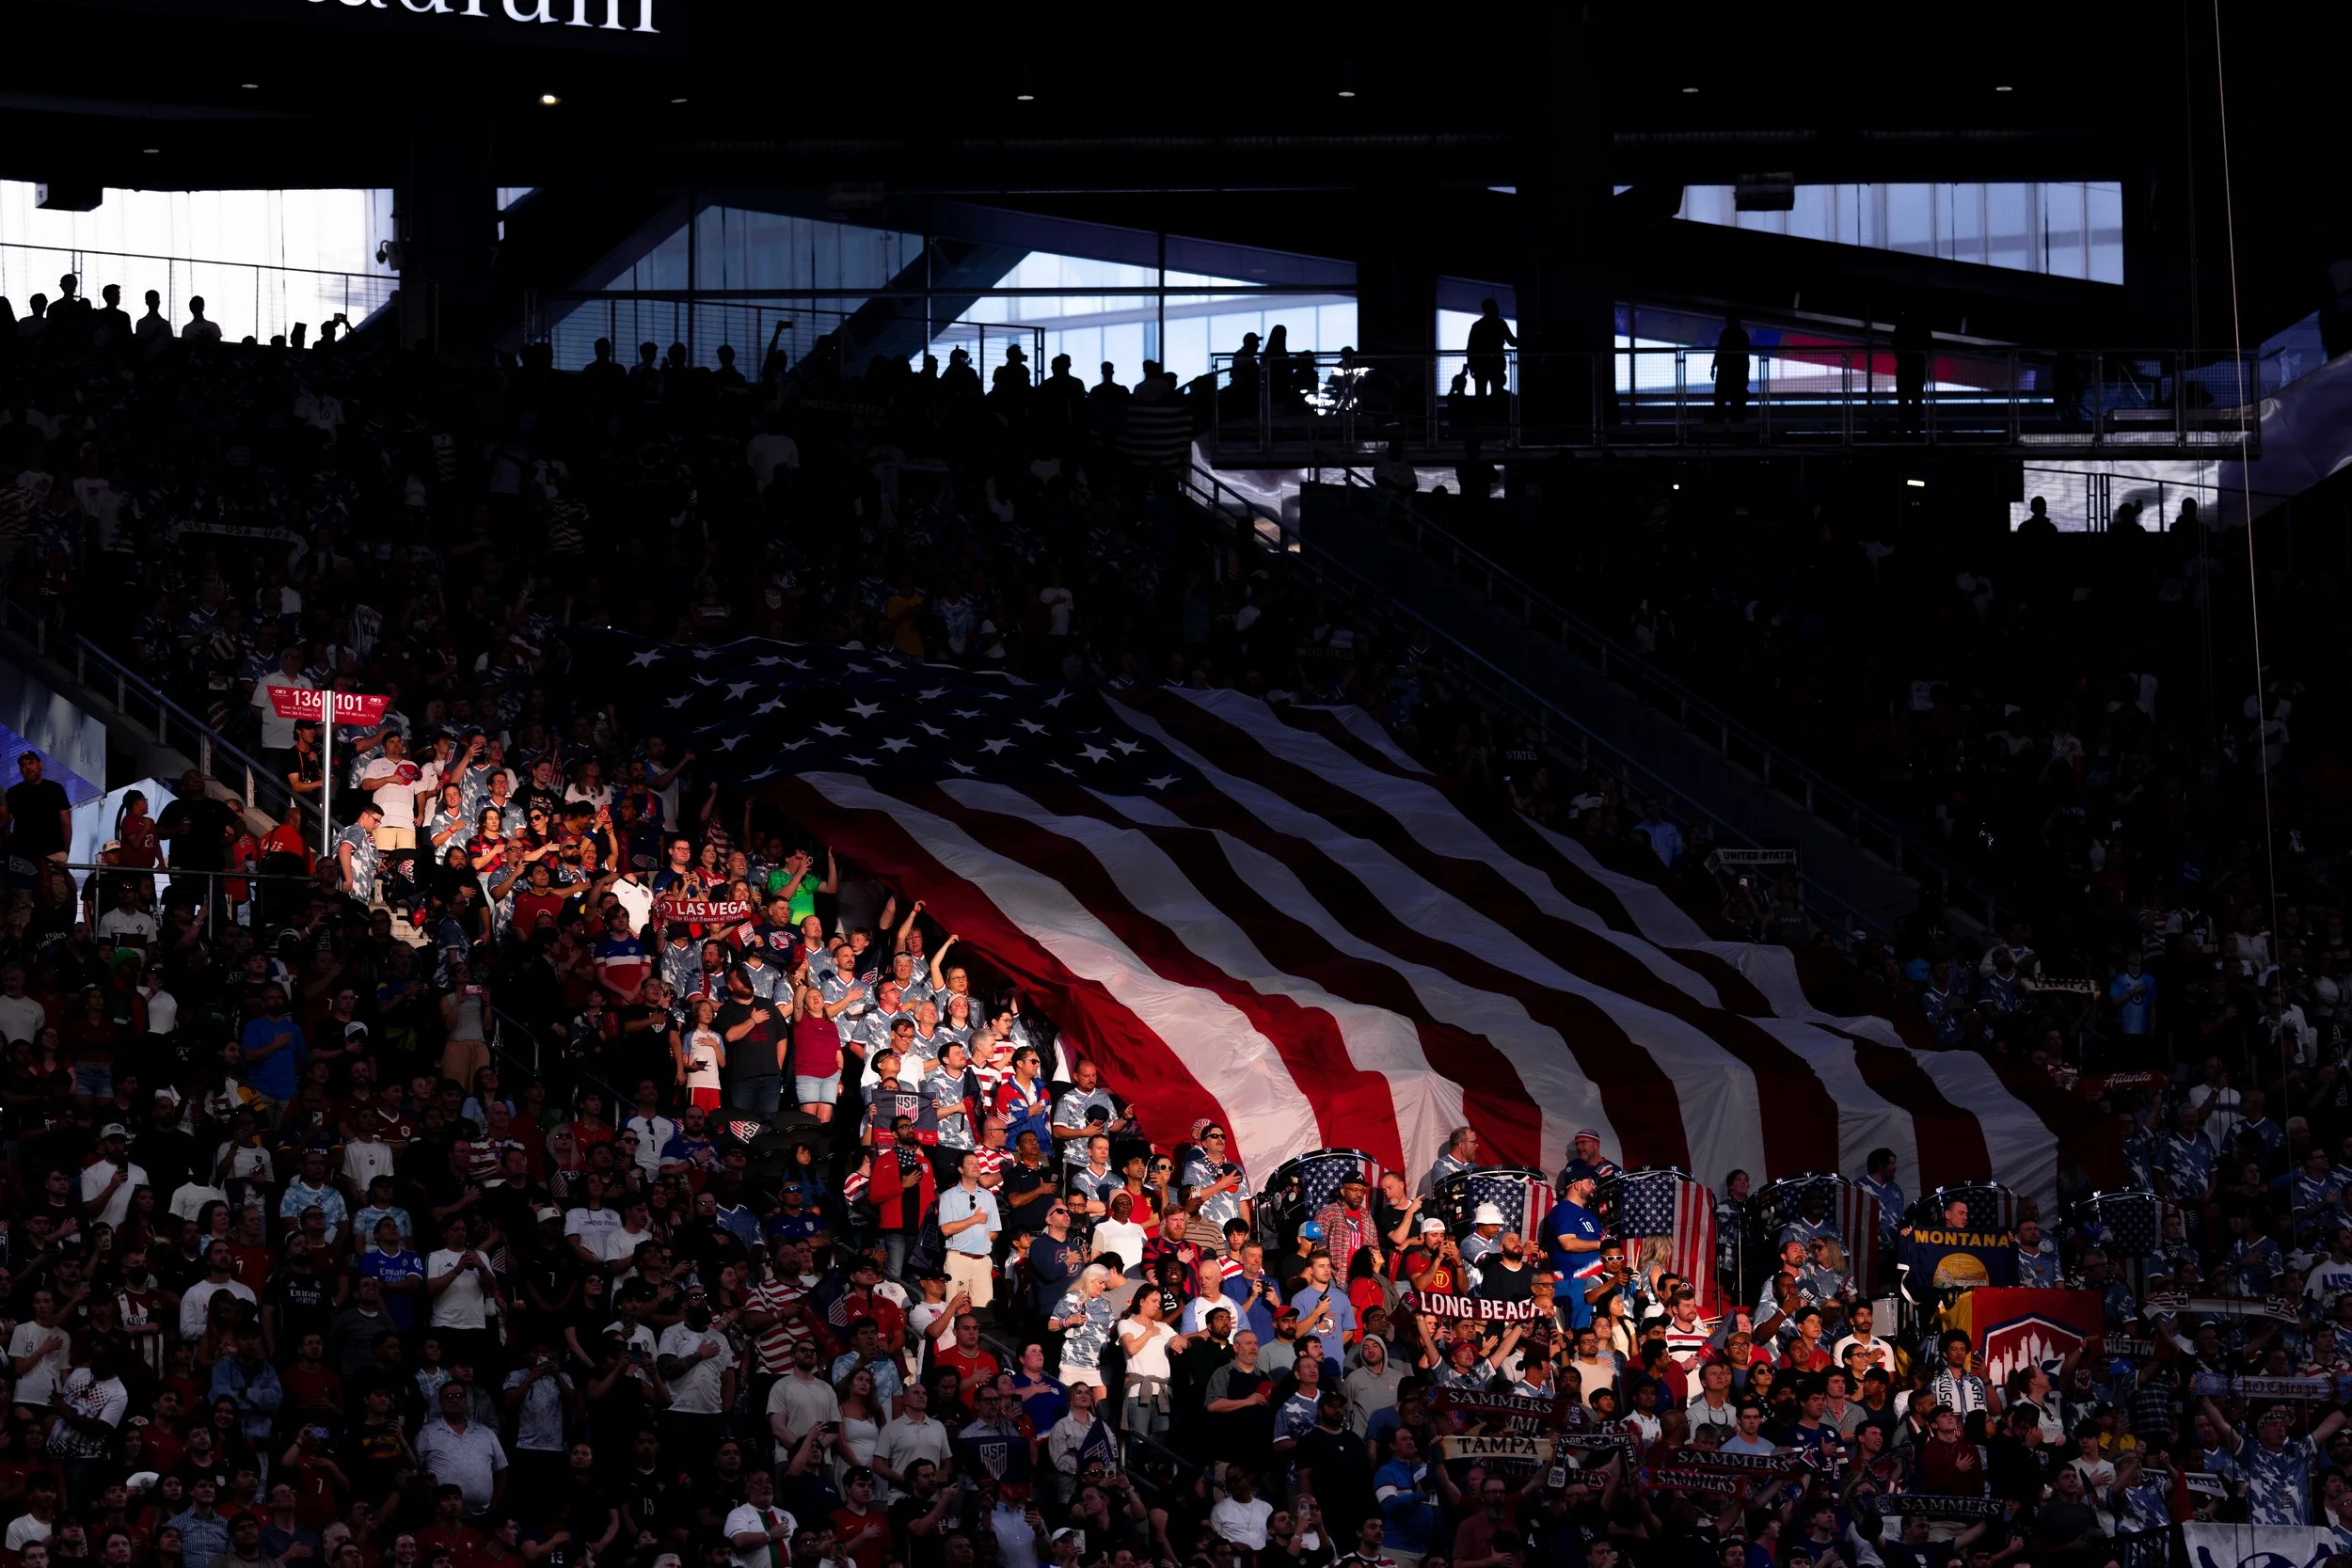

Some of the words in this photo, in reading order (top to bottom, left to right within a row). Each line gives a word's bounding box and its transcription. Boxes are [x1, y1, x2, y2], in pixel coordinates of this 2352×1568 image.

[293, 689, 322, 707] 136
[335, 693, 362, 712] 101
[1724, 851, 1758, 860] UNITED
[676, 902, 706, 915] LAS
[708, 901, 748, 915] VEGA
[2103, 1070, 2153, 1088] Atlanta
[898, 1096, 917, 1109] USA
[1582, 1221, 1595, 1233] 10
[1915, 1229, 2010, 1249] MONTANA
[379, 1266, 407, 1276] Emirate
[1436, 1273, 1444, 1285] 17
[289, 1288, 321, 1298] Emirates
[1421, 1291, 1472, 1318] LONG
[1481, 1299, 1544, 1320] BEACH
[2104, 1338, 2155, 1357] AUSTIN
[2266, 1382, 2319, 1396] Chicago
[1449, 1390, 1553, 1414] SAMMERS
[982, 1445, 1006, 1459] USA
[1457, 1437, 1538, 1455] TAMPA
[1677, 1450, 1791, 1471] SAMMERS
[1656, 1469, 1739, 1494] SAMMERS
[644, 1497, 655, 1516] 13
[1900, 1497, 2000, 1515] SAMMERS
[550, 1551, 564, 1564] 13
